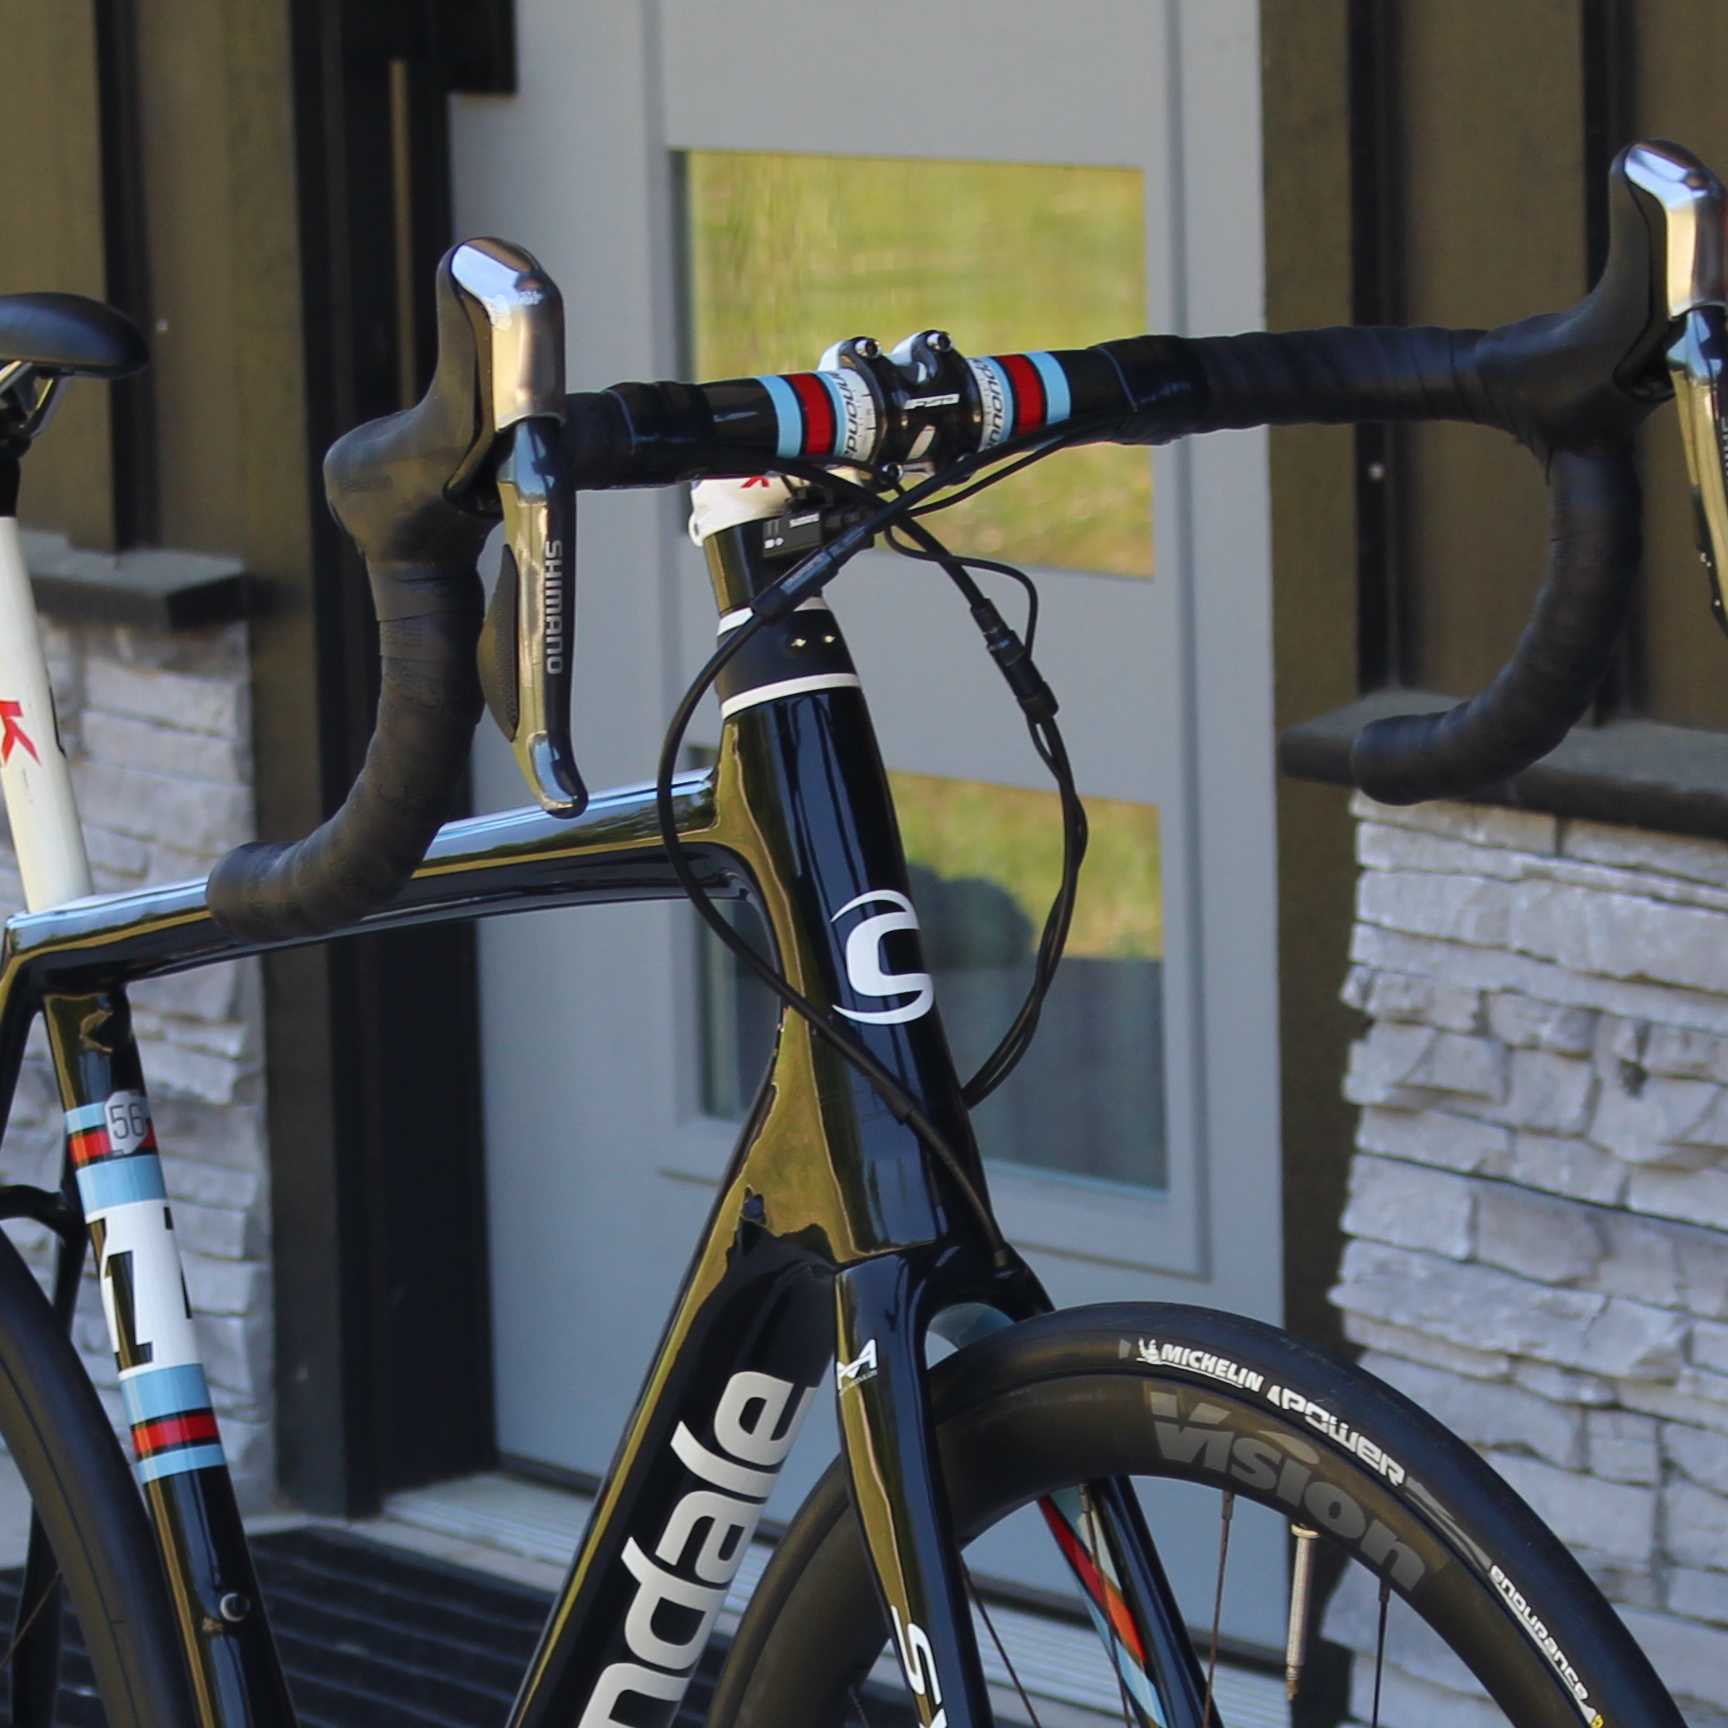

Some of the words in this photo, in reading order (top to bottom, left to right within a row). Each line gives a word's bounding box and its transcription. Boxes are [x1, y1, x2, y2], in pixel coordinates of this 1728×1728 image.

[544, 539, 564, 675] SHIMANO
[110, 1104, 146, 1141] 56
[1159, 1343, 1264, 1393] MICHELIN
[1149, 1391, 1427, 1592] Vision
